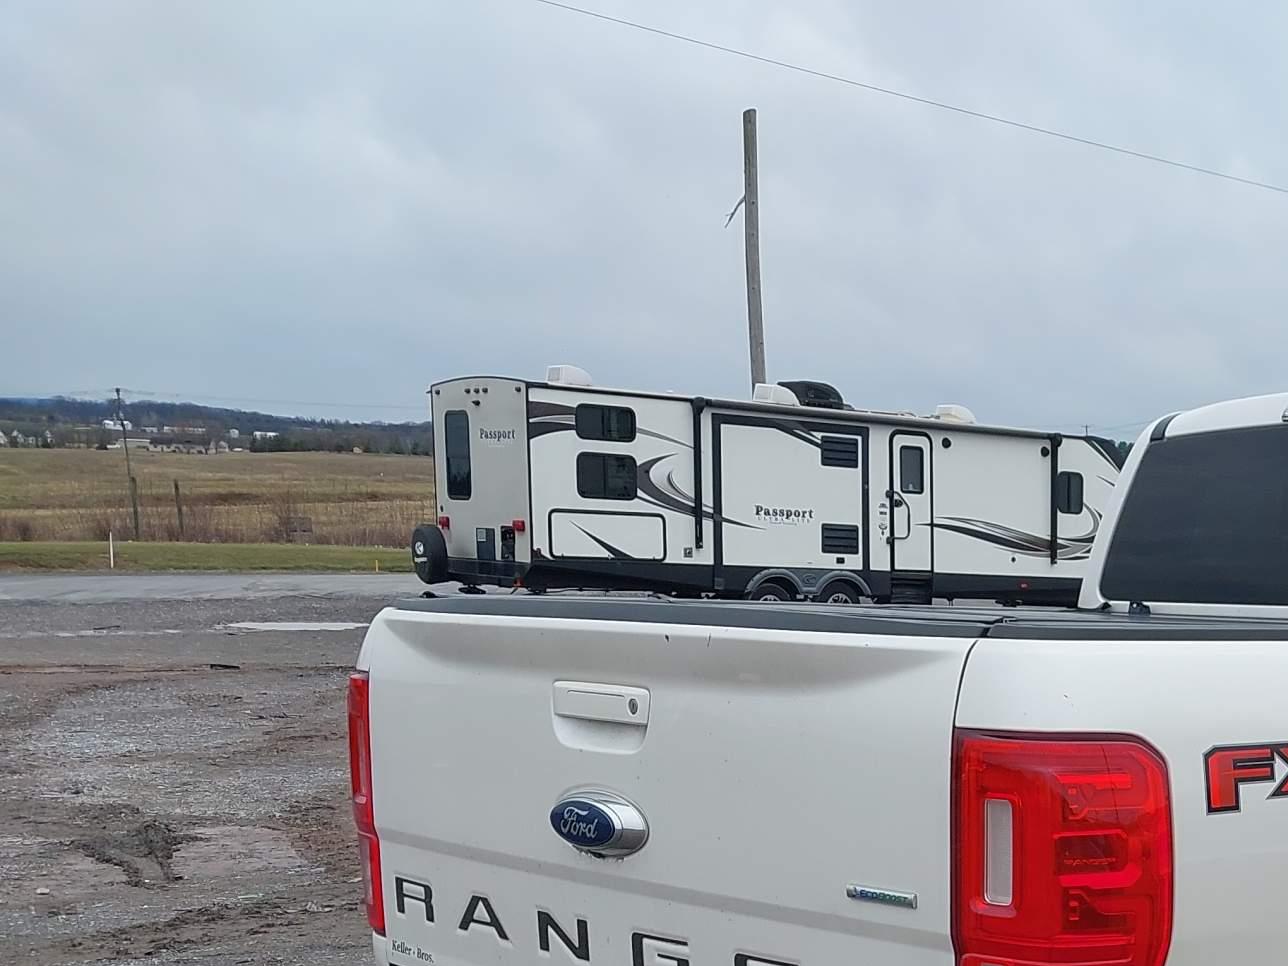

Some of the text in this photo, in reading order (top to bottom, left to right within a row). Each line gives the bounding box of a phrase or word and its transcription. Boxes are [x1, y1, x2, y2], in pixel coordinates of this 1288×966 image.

[479, 428, 516, 441] Passport
[755, 504, 814, 520] Passport
[560, 806, 599, 839] Ford
